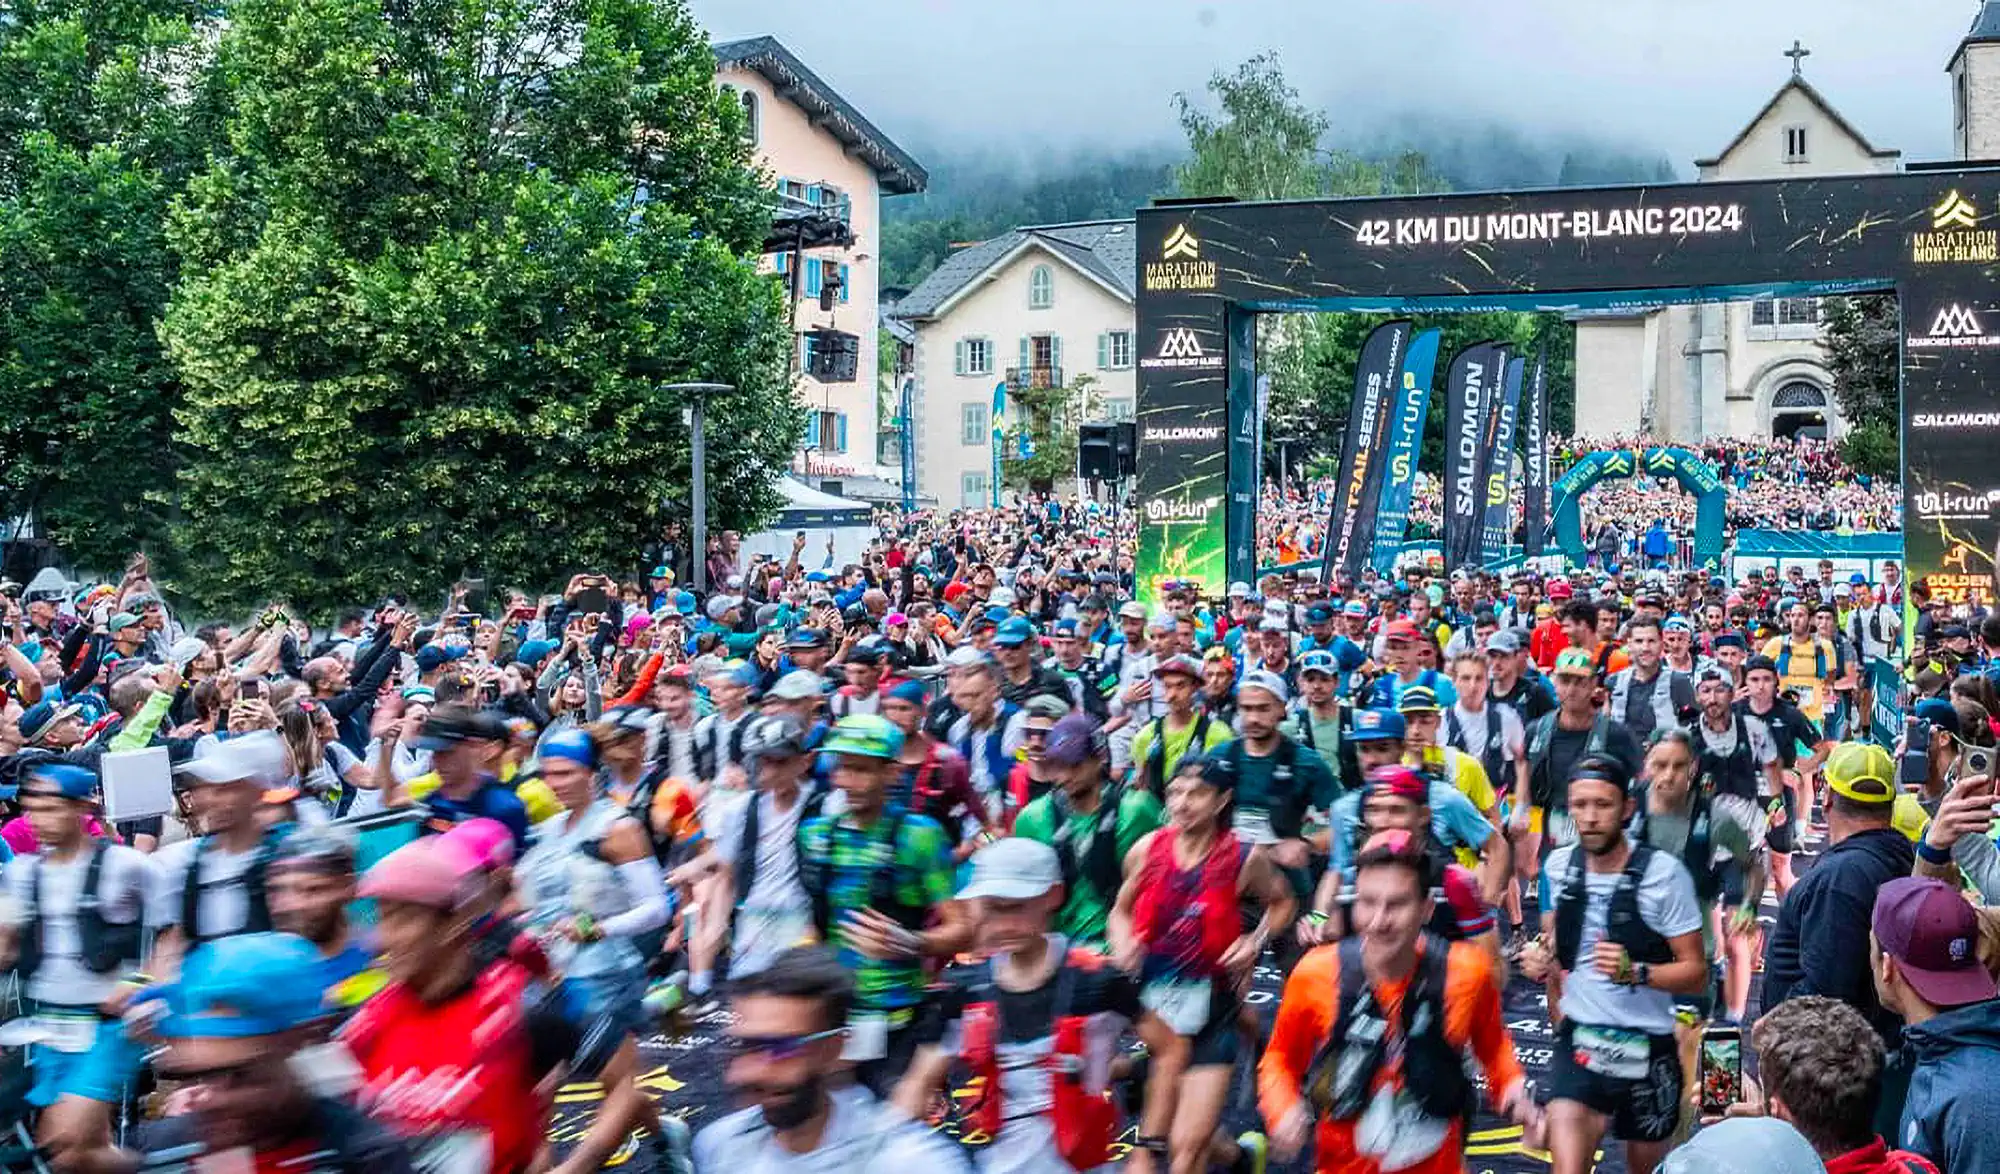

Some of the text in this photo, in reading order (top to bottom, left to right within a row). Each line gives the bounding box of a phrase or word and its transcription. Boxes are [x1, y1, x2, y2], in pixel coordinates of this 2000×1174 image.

[1356, 204, 1742, 246] 42 KM DU MONT-BLANC 2024
[1914, 230, 1997, 249] MARATHON
[1146, 261, 1216, 278] MARATHON
[1912, 413, 2000, 428] SALOMON
[1144, 427, 1219, 441] SALOMON
[1456, 362, 1483, 516] SALOMON
